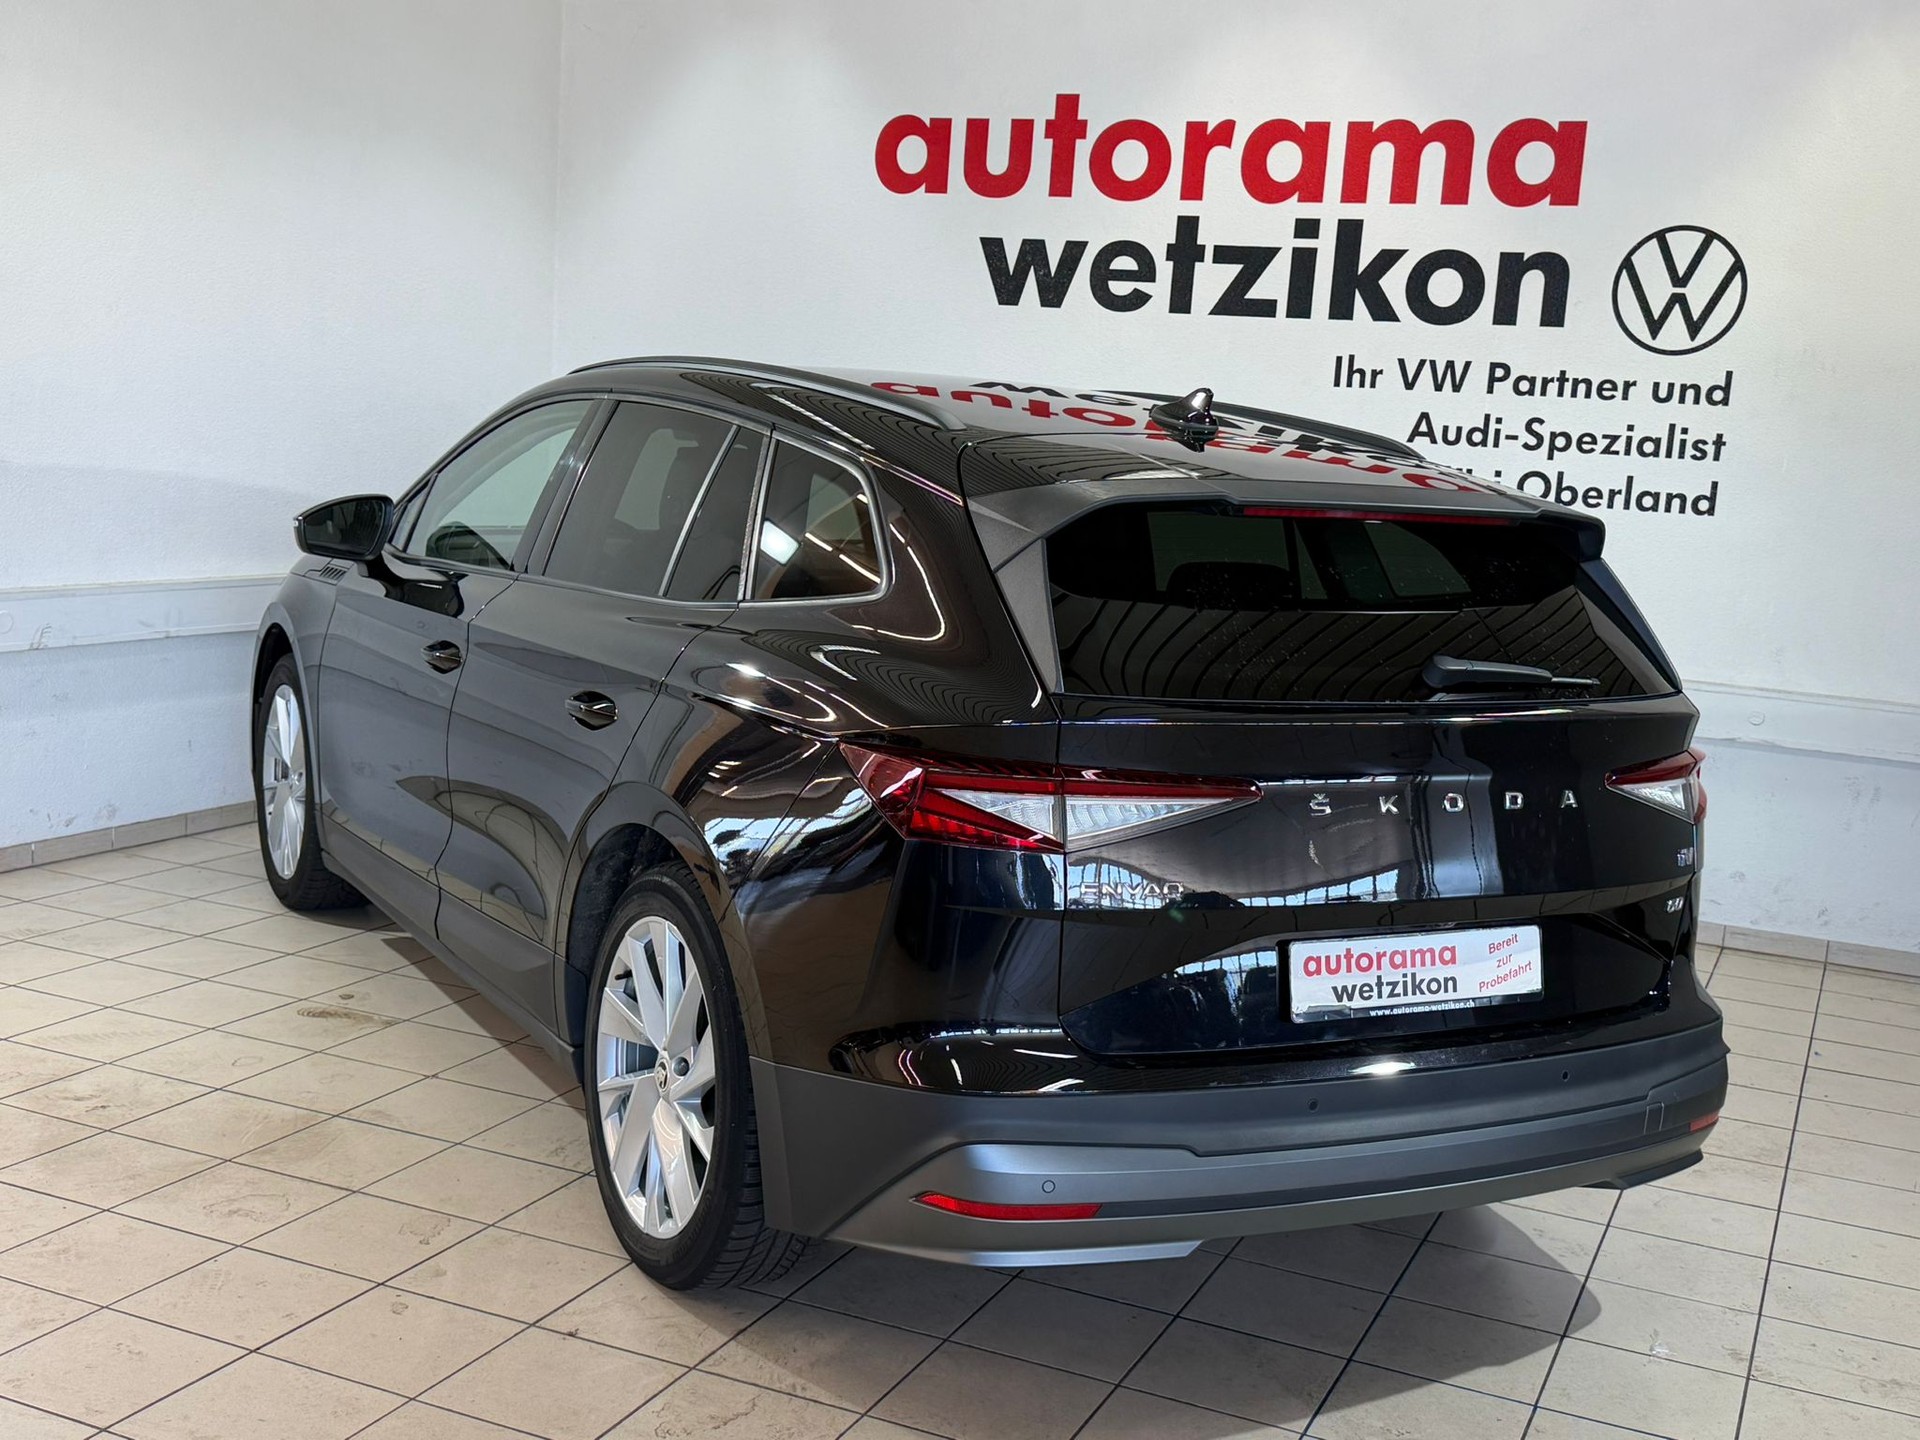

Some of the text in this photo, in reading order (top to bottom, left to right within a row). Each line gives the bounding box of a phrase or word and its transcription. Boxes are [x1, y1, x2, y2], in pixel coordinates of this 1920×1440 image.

[875, 93, 1588, 208] autorama
[979, 215, 1570, 328] wetzikon
[1332, 354, 1734, 407] Ihr VW Partner und
[1406, 411, 1727, 463] Audi-Spezialist
[1516, 470, 1719, 517] Oberland
[1309, 789, 1578, 817] ŠKODA
[1488, 933, 1519, 955] Bereit
[1495, 952, 1513, 969] zur
[1302, 945, 1458, 978] autorama
[1478, 960, 1533, 993] Probefahrt
[1331, 972, 1458, 1003] wetzikon
[1369, 999, 1475, 1017] www.autorama-wetzikon.ch
